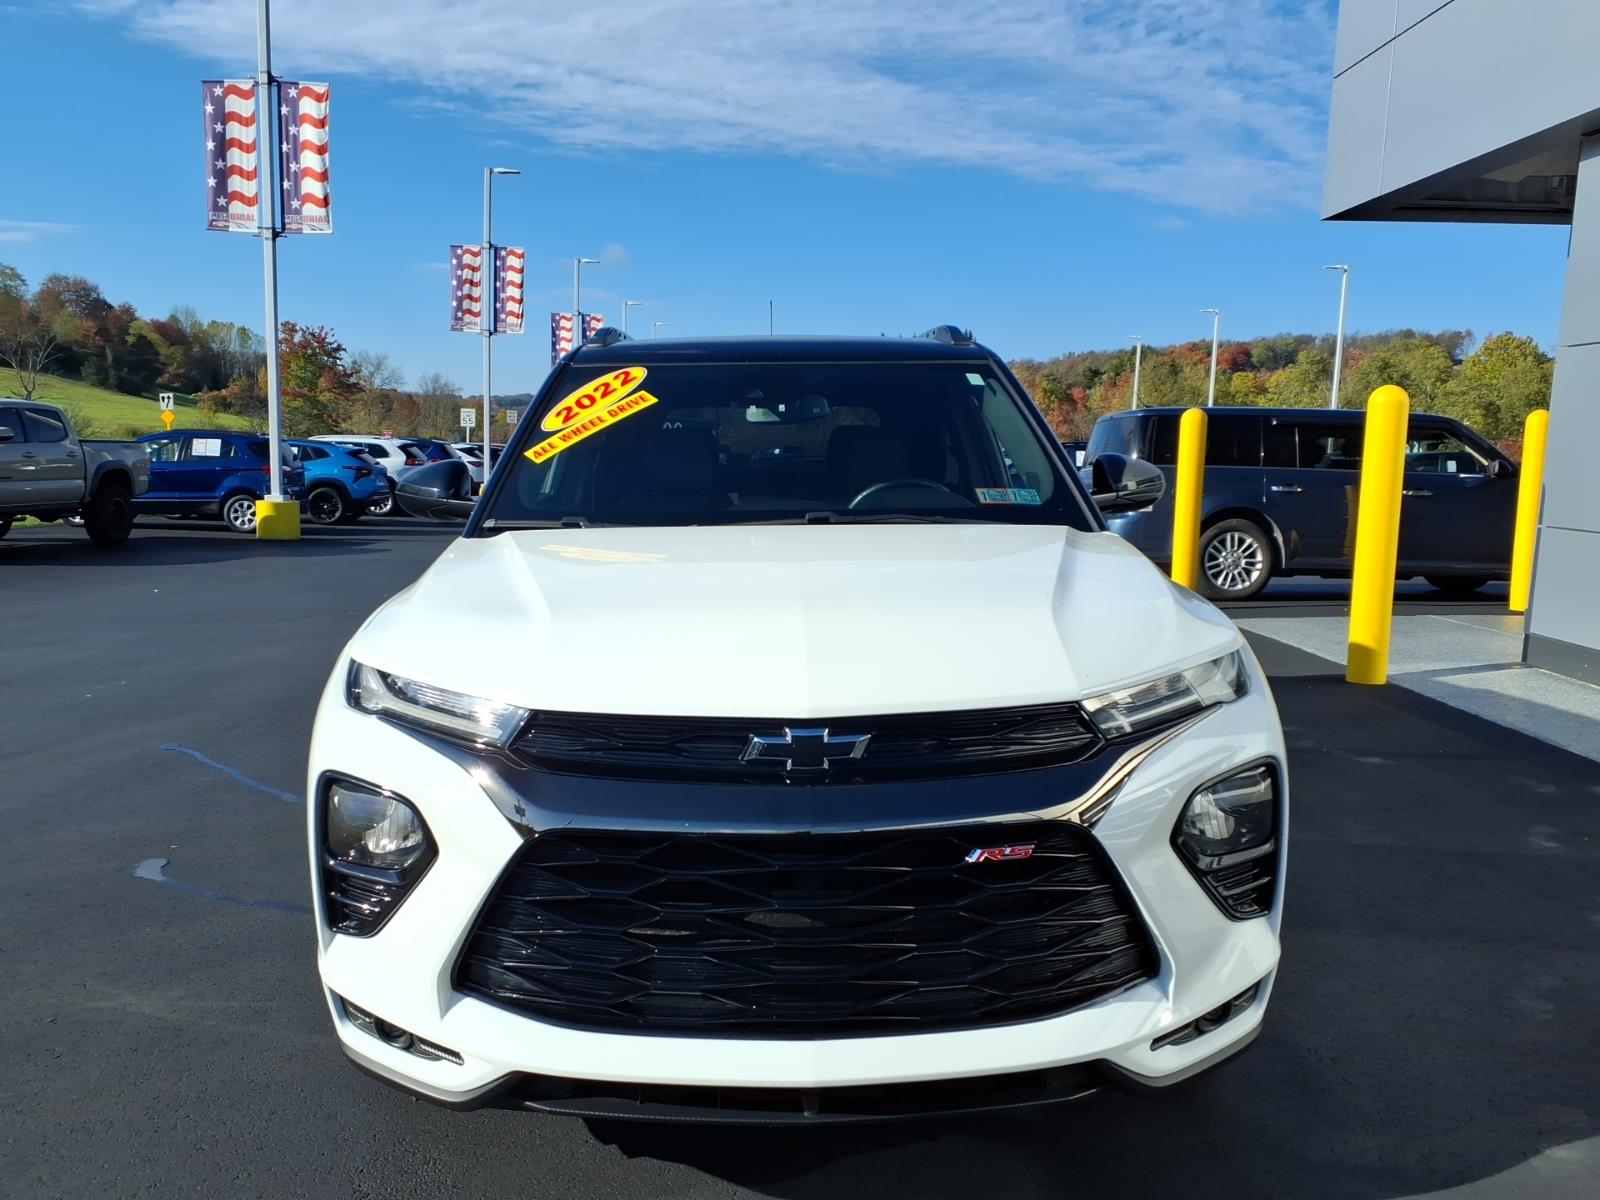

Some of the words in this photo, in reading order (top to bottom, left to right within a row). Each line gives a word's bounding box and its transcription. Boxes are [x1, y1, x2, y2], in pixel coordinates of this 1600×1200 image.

[555, 370, 637, 425] 2022
[462, 417, 474, 425] 55
[532, 441, 558, 460] ALL
[558, 415, 608, 443] WHEEL
[607, 393, 650, 418] DRIVE
[965, 845, 1036, 863] RS
